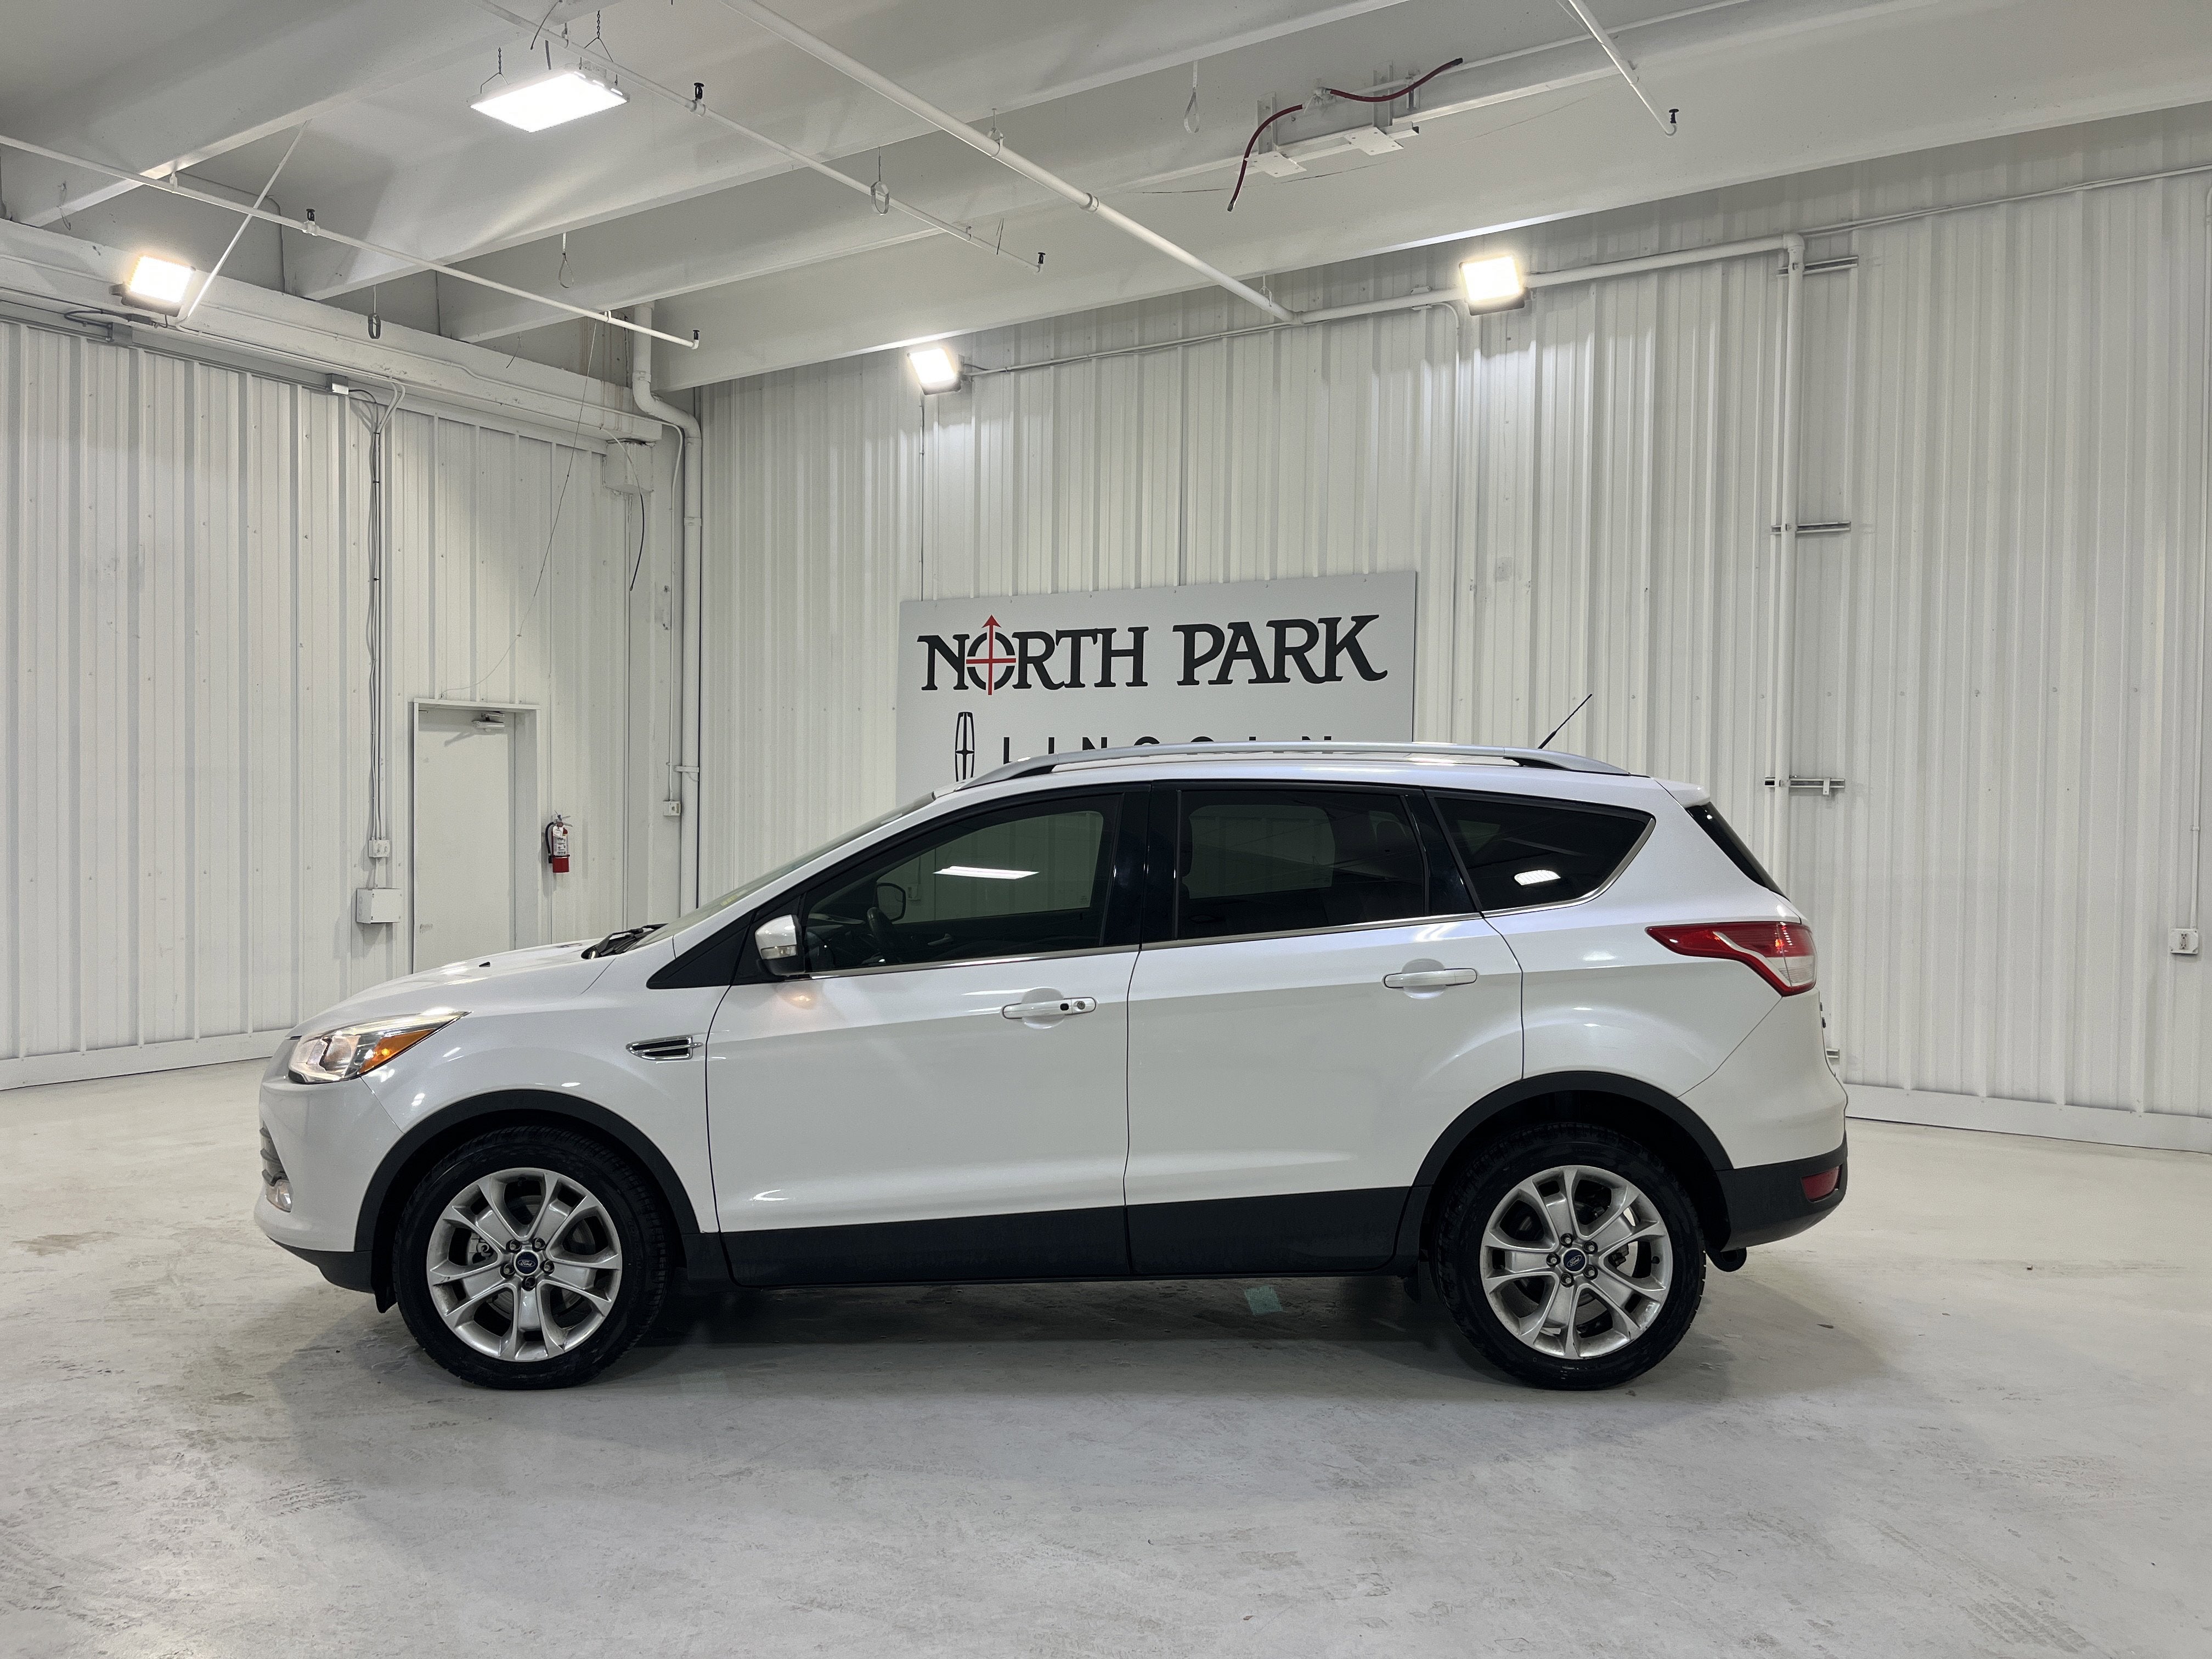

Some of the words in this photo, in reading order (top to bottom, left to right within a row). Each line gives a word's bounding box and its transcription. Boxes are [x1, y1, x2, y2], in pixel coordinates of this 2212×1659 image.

[917, 625, 1149, 691] NORTH
[1172, 614, 1388, 686] PARK
[1569, 1256, 1580, 1266] Ford
